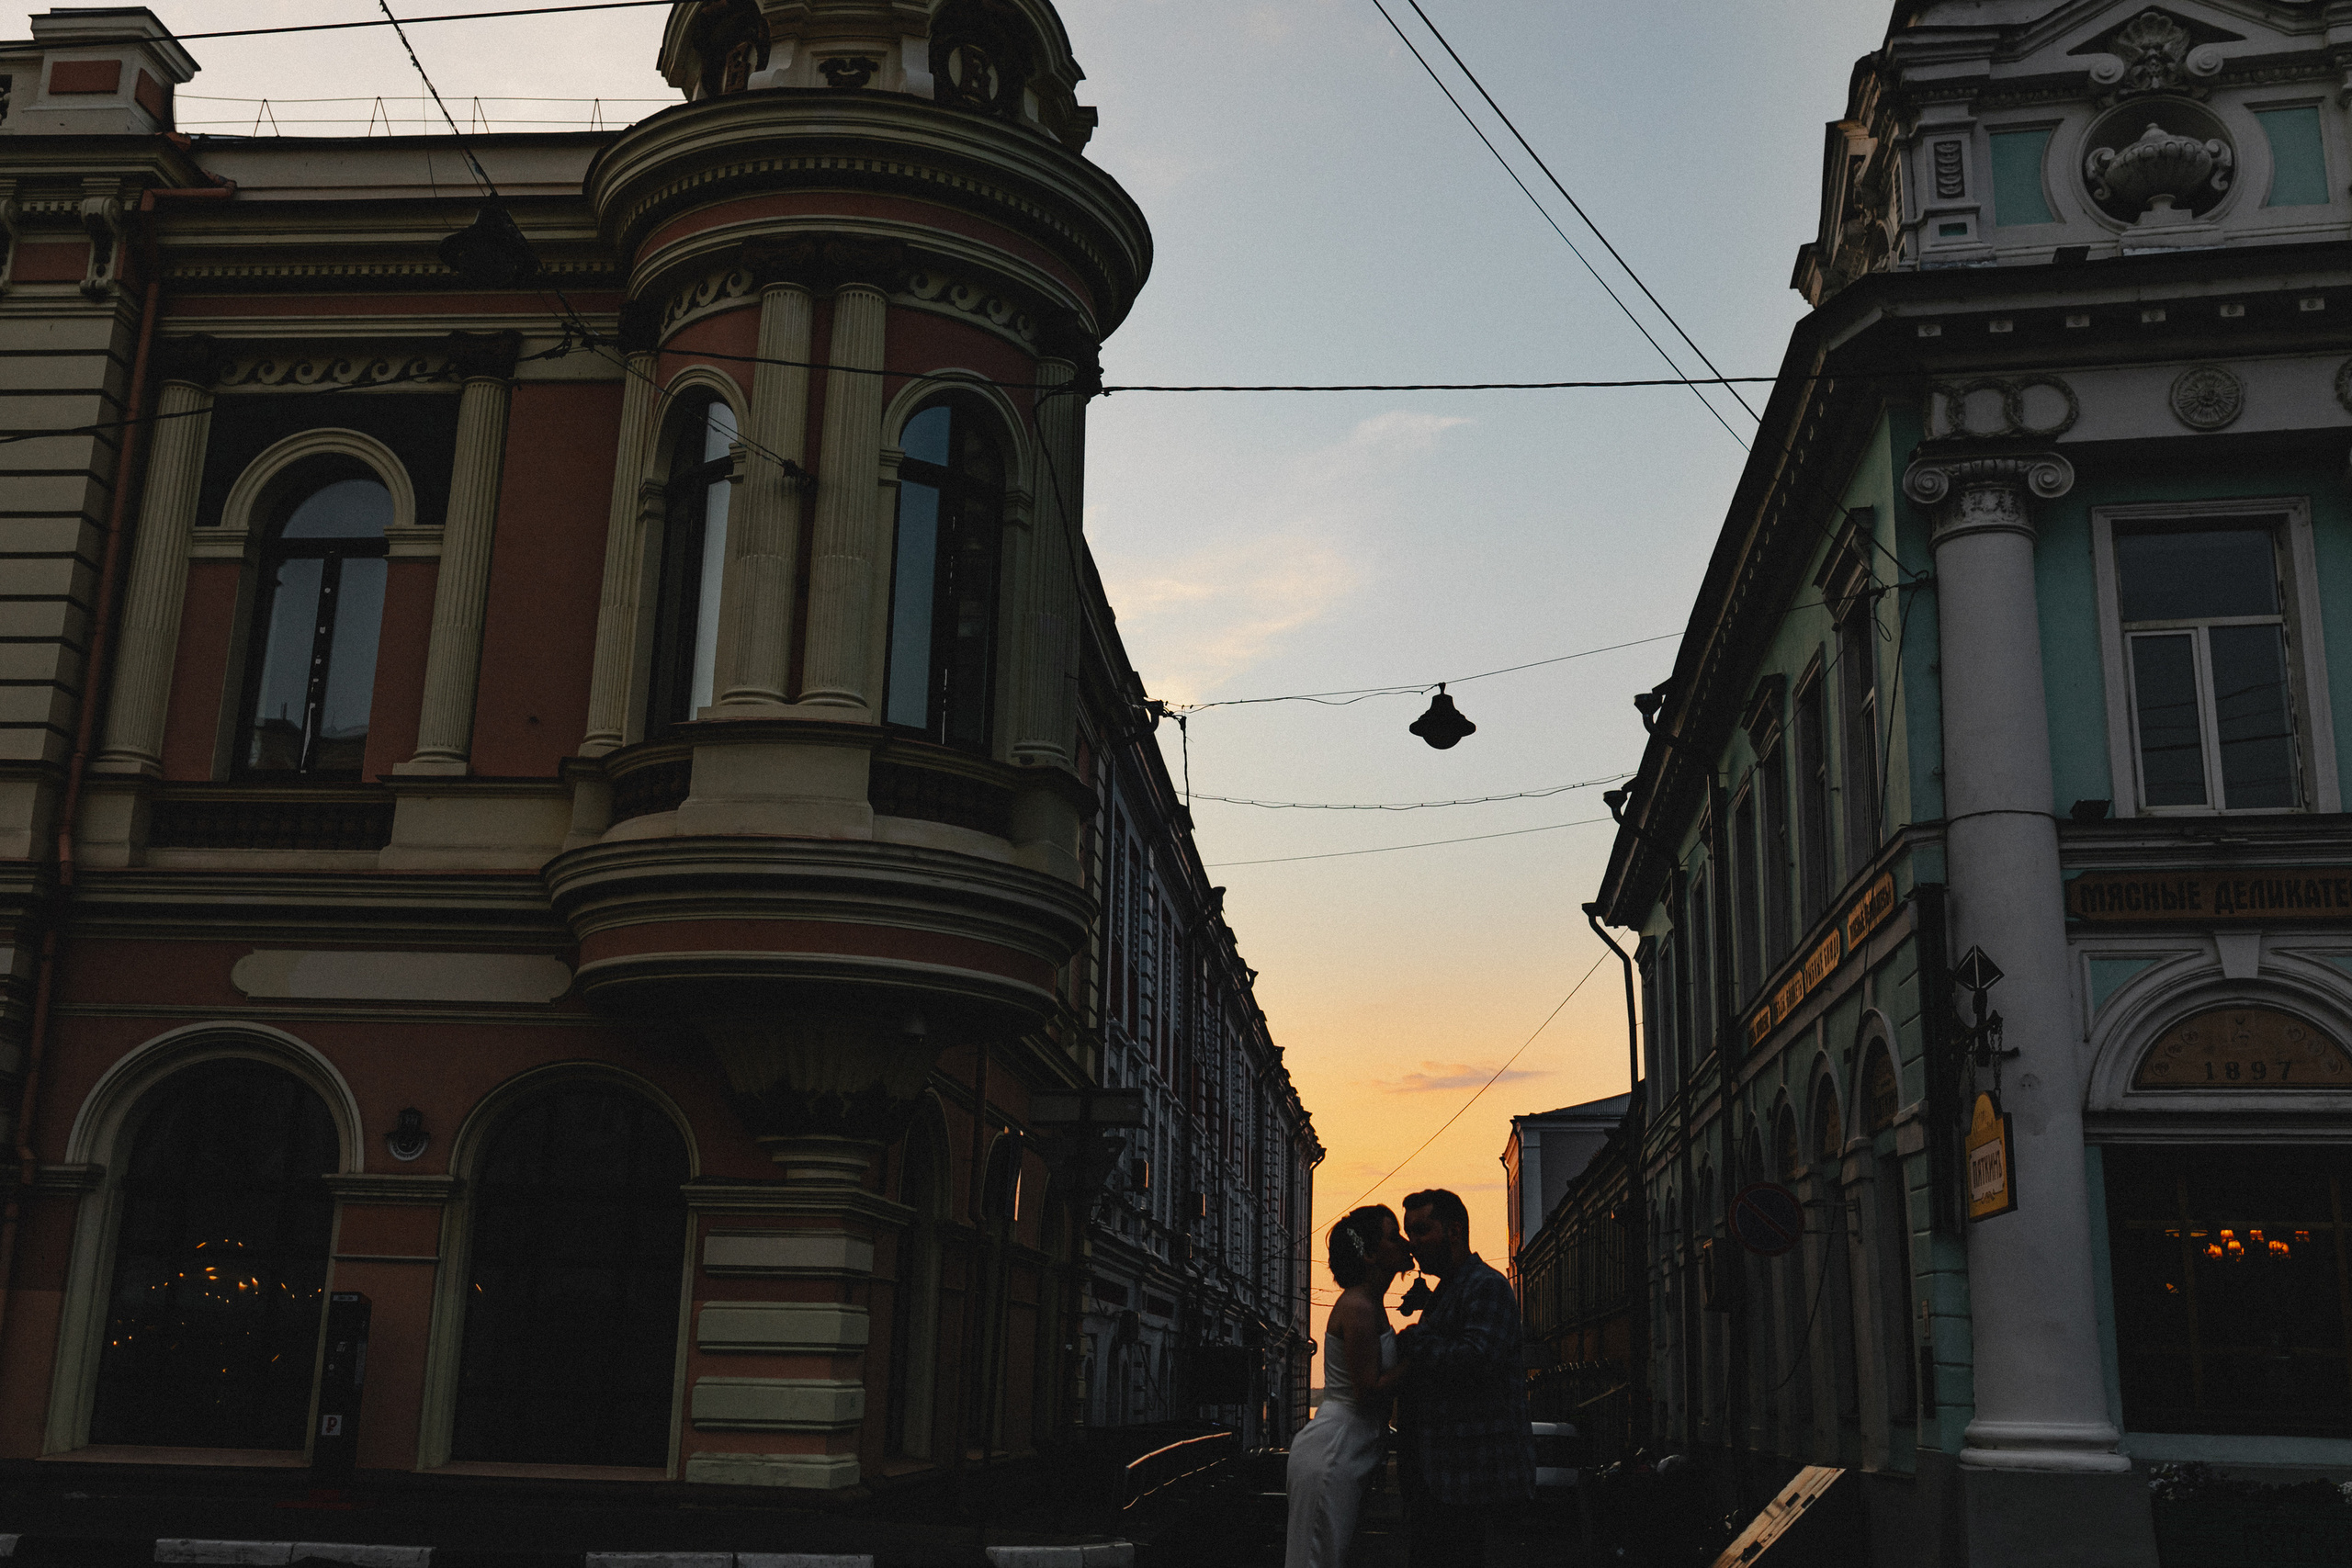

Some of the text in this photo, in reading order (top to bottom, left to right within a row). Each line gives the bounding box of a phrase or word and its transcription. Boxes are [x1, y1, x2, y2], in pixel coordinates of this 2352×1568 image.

[2080, 877, 2352, 915] МЯСНЫЕ ДЕЛИКАТЕ
[2204, 1060, 2291, 1081] 1897
[1973, 1150, 2003, 1189] ПЯТКИНЪ
